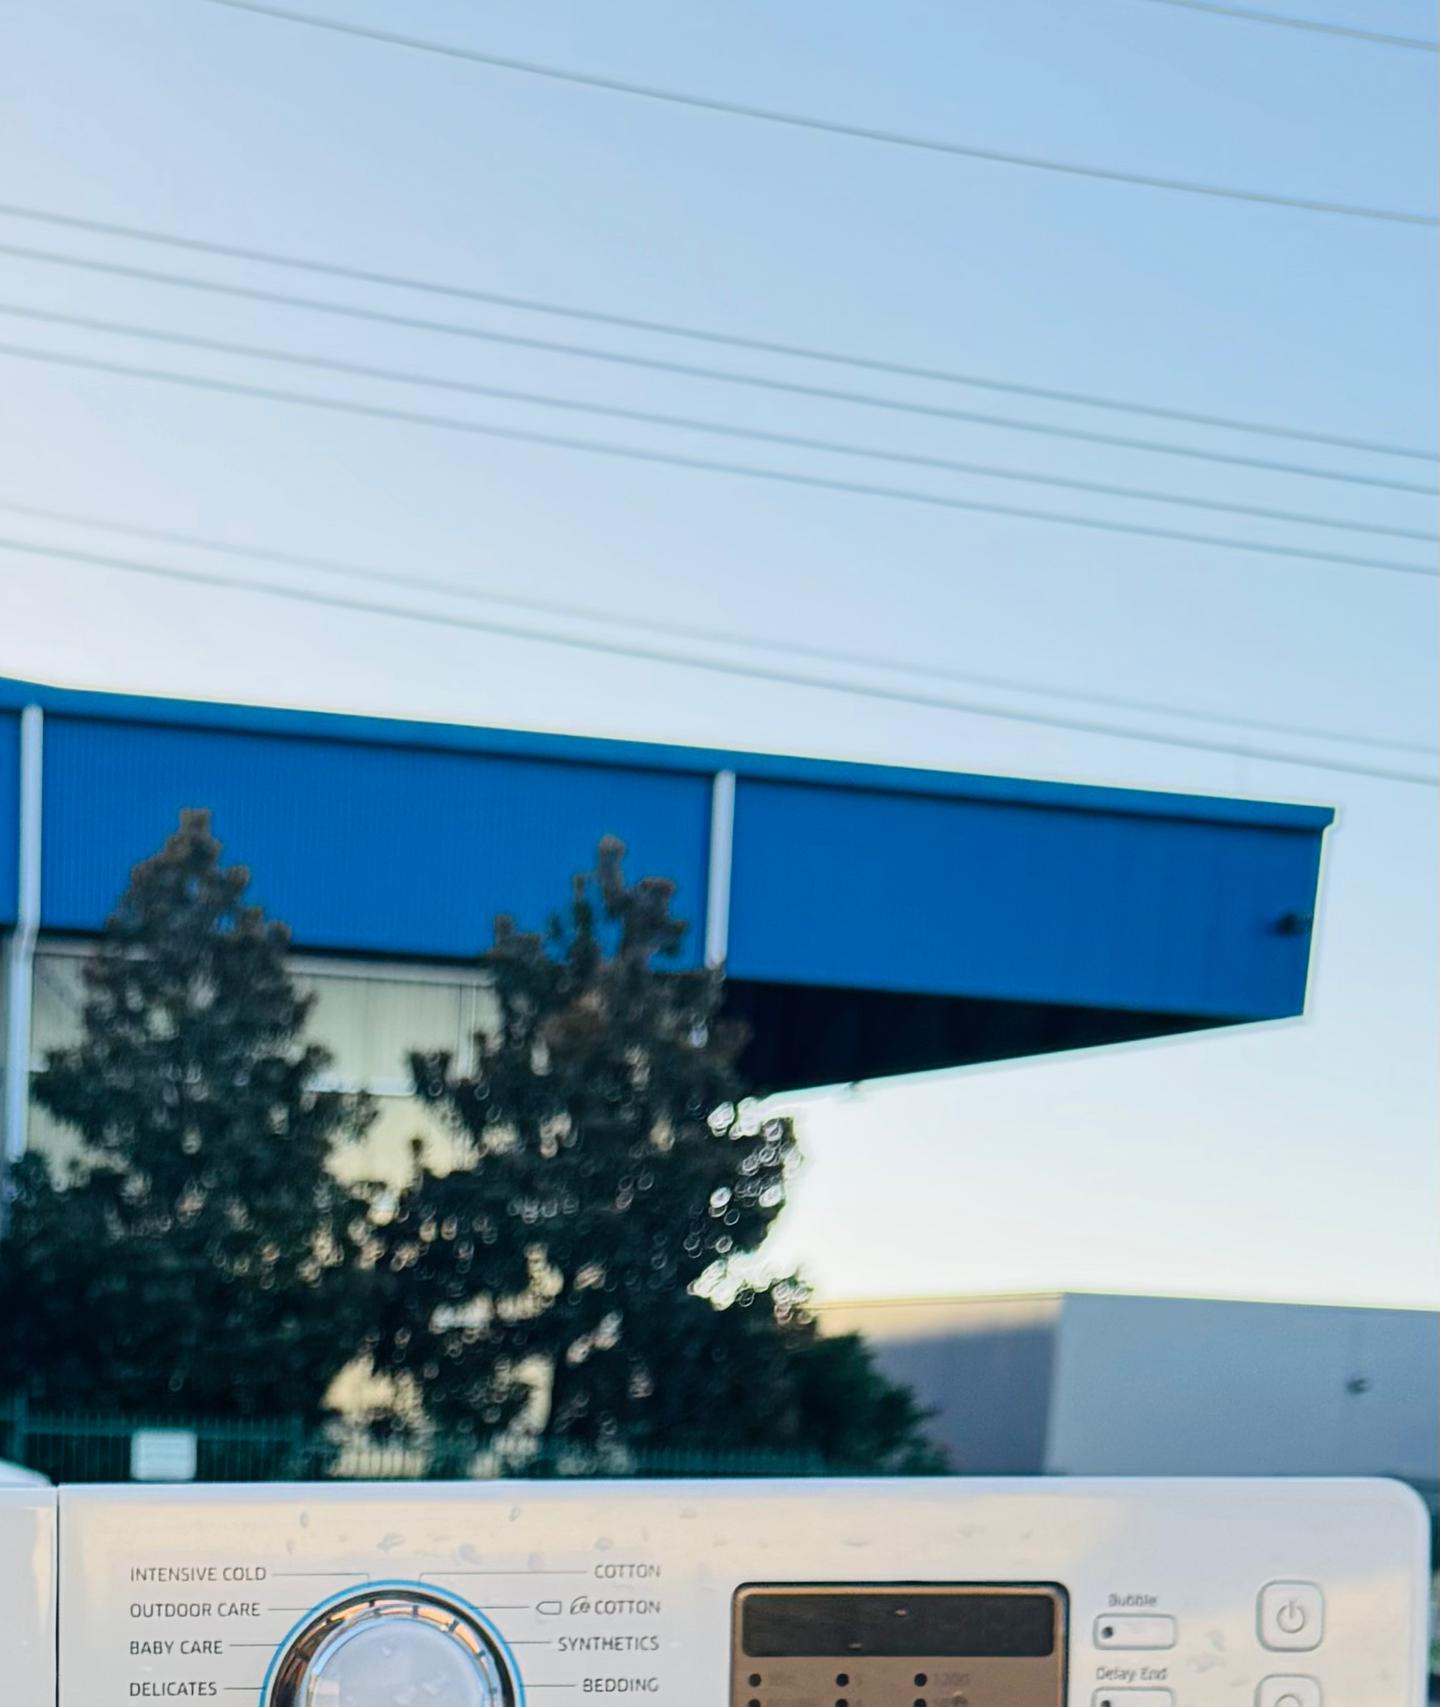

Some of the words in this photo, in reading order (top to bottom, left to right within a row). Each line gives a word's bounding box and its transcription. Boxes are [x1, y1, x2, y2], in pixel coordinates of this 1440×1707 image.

[131, 1568, 219, 1581] INTENSIVE
[223, 1567, 267, 1582] COLD
[594, 1565, 660, 1578] COTTON
[594, 1600, 660, 1614] COTTON
[1108, 1594, 1157, 1607] Bubble
[130, 1603, 212, 1617] OUTDOOR
[217, 1603, 261, 1616] CARE
[129, 1641, 174, 1654] BABY
[179, 1640, 223, 1654] CARE
[558, 1636, 660, 1651] SYNTHETICS
[1096, 1667, 1135, 1682] Delay
[1139, 1667, 1167, 1681] End
[129, 1681, 217, 1696] DELICATES
[583, 1678, 659, 1693] BEDDING
